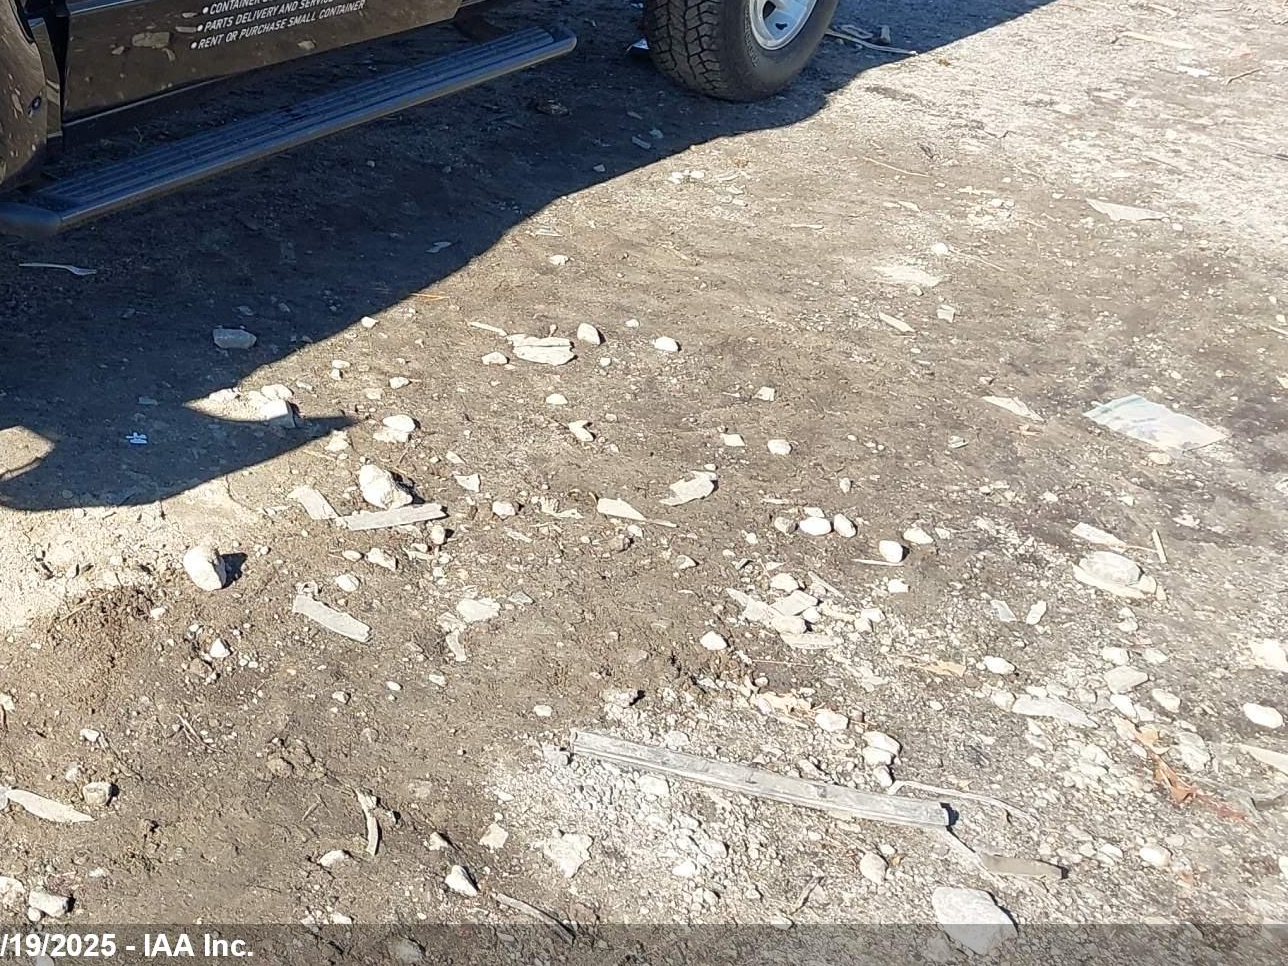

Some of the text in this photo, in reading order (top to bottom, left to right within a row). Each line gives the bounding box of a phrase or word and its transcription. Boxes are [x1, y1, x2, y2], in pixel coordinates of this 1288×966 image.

[198, 0, 366, 49] RENT OR PURCHASE SMALL CONTAINER
[204, 15, 233, 32] PARTS
[235, 6, 279, 25] DELIVERY
[279, 0, 298, 14] AND
